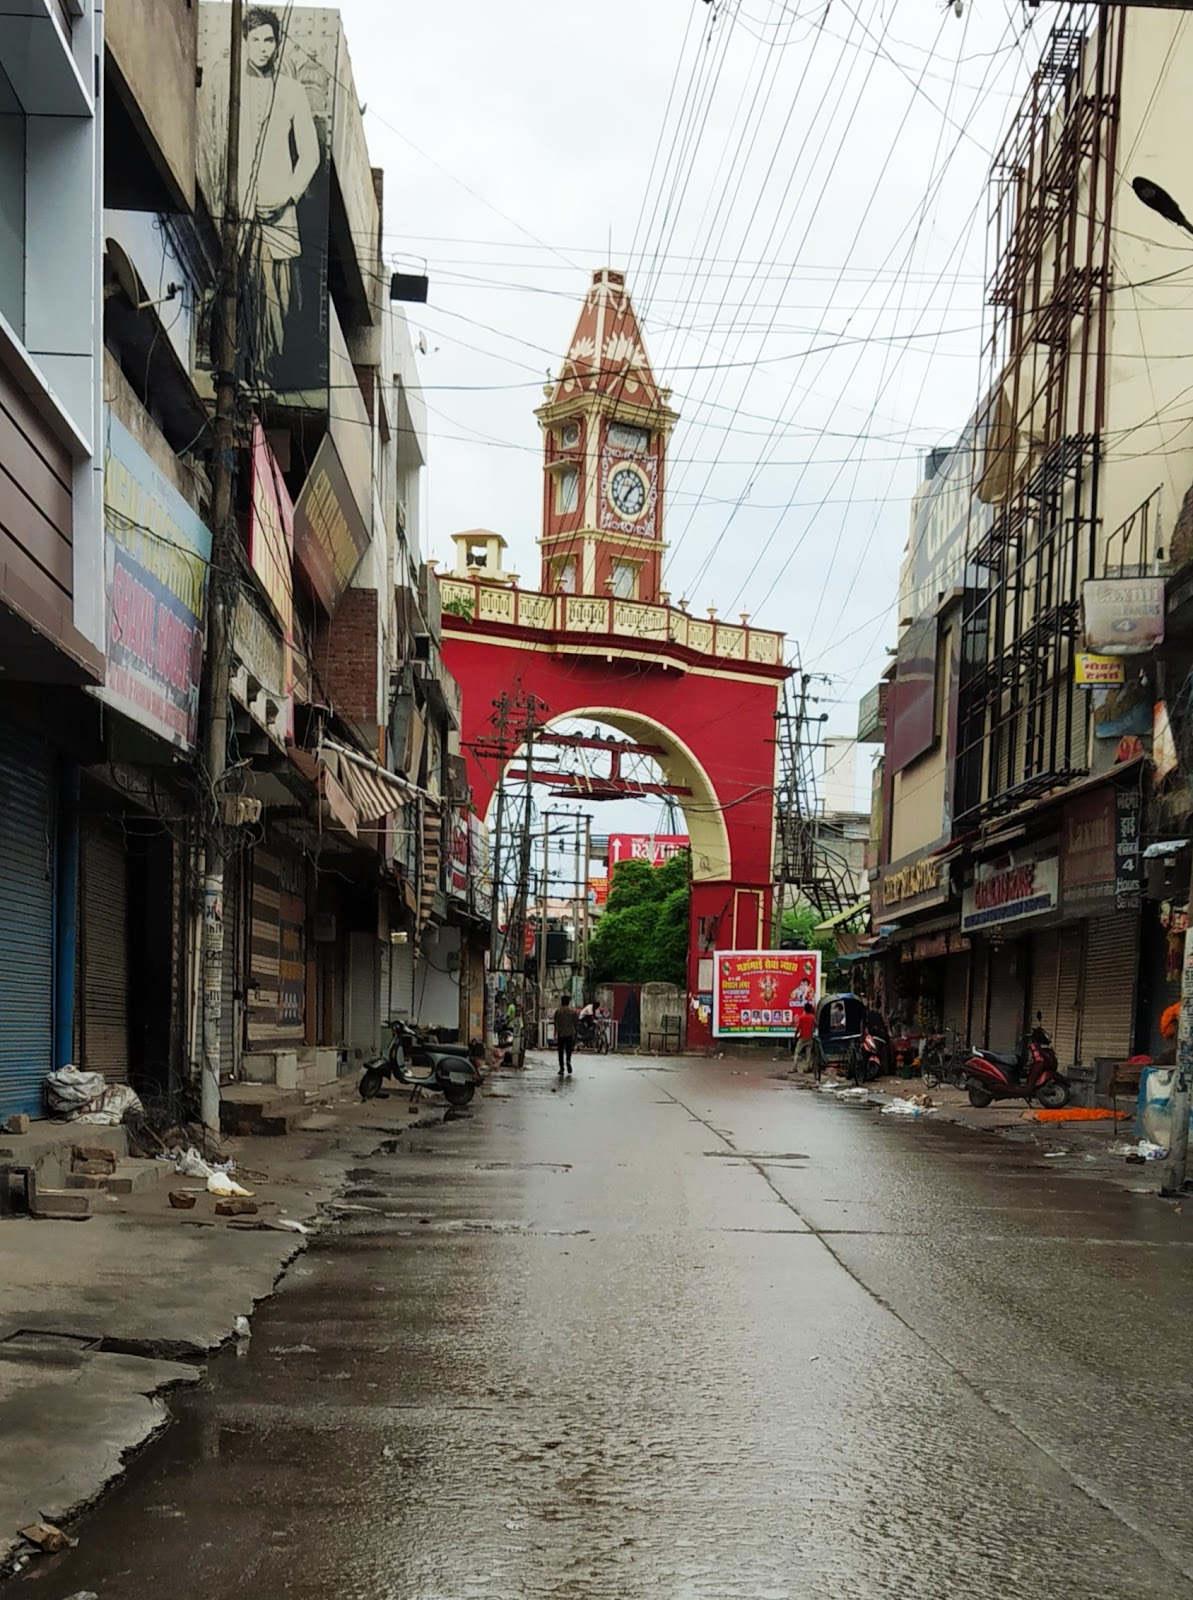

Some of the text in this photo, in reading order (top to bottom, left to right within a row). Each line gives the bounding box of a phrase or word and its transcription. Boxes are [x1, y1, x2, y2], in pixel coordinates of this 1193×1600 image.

[1093, 583, 1160, 602] Laxmi
[156, 603, 192, 693] HOUSE
[1121, 858, 1135, 872] 4
[1116, 876, 1141, 892] Hours
